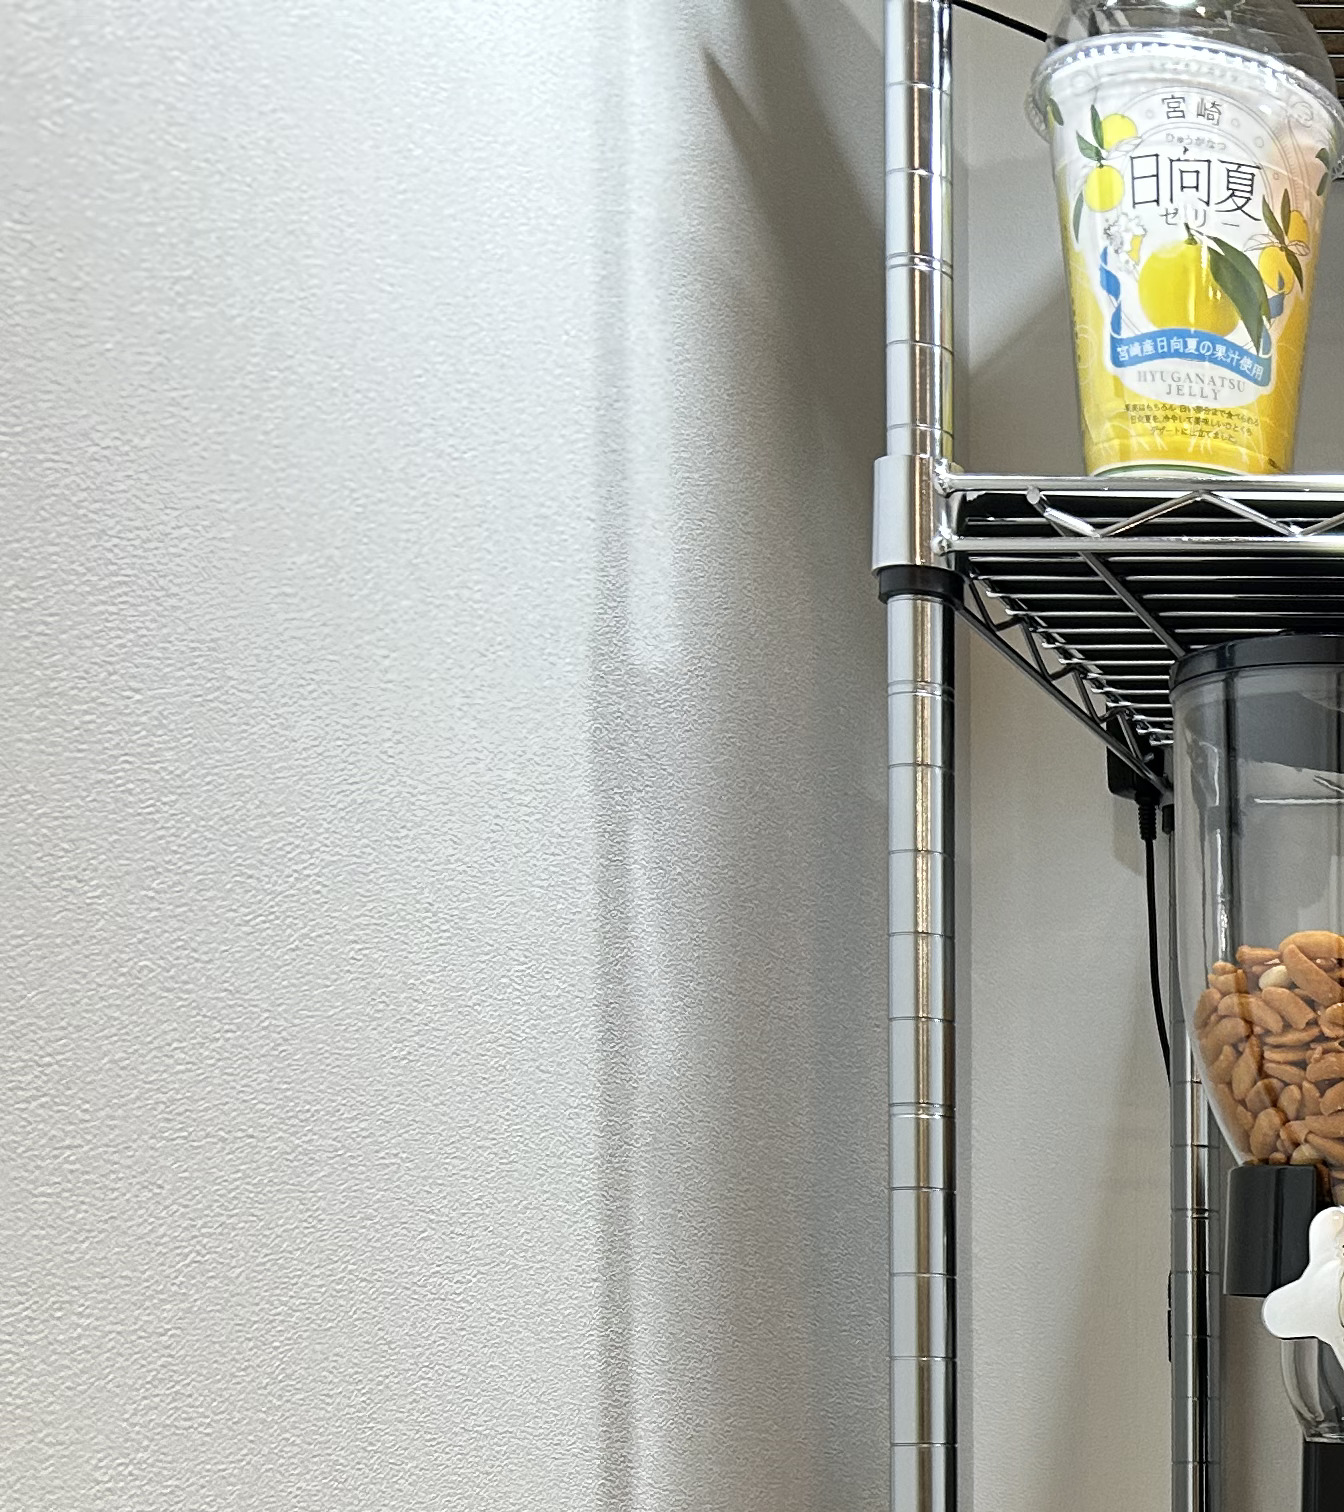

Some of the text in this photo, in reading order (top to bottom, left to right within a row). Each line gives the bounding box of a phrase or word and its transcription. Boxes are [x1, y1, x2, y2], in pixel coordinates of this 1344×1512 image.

[1161, 93, 1222, 126] 宮崎
[1130, 145, 1262, 222] 日向夏
[1159, 207, 1240, 228] ゼリー
[1116, 336, 1264, 382] 宮崎産日向夏の果汁使用
[1136, 370, 1246, 393] HYUGANATSU
[1165, 383, 1221, 401] JELLY
